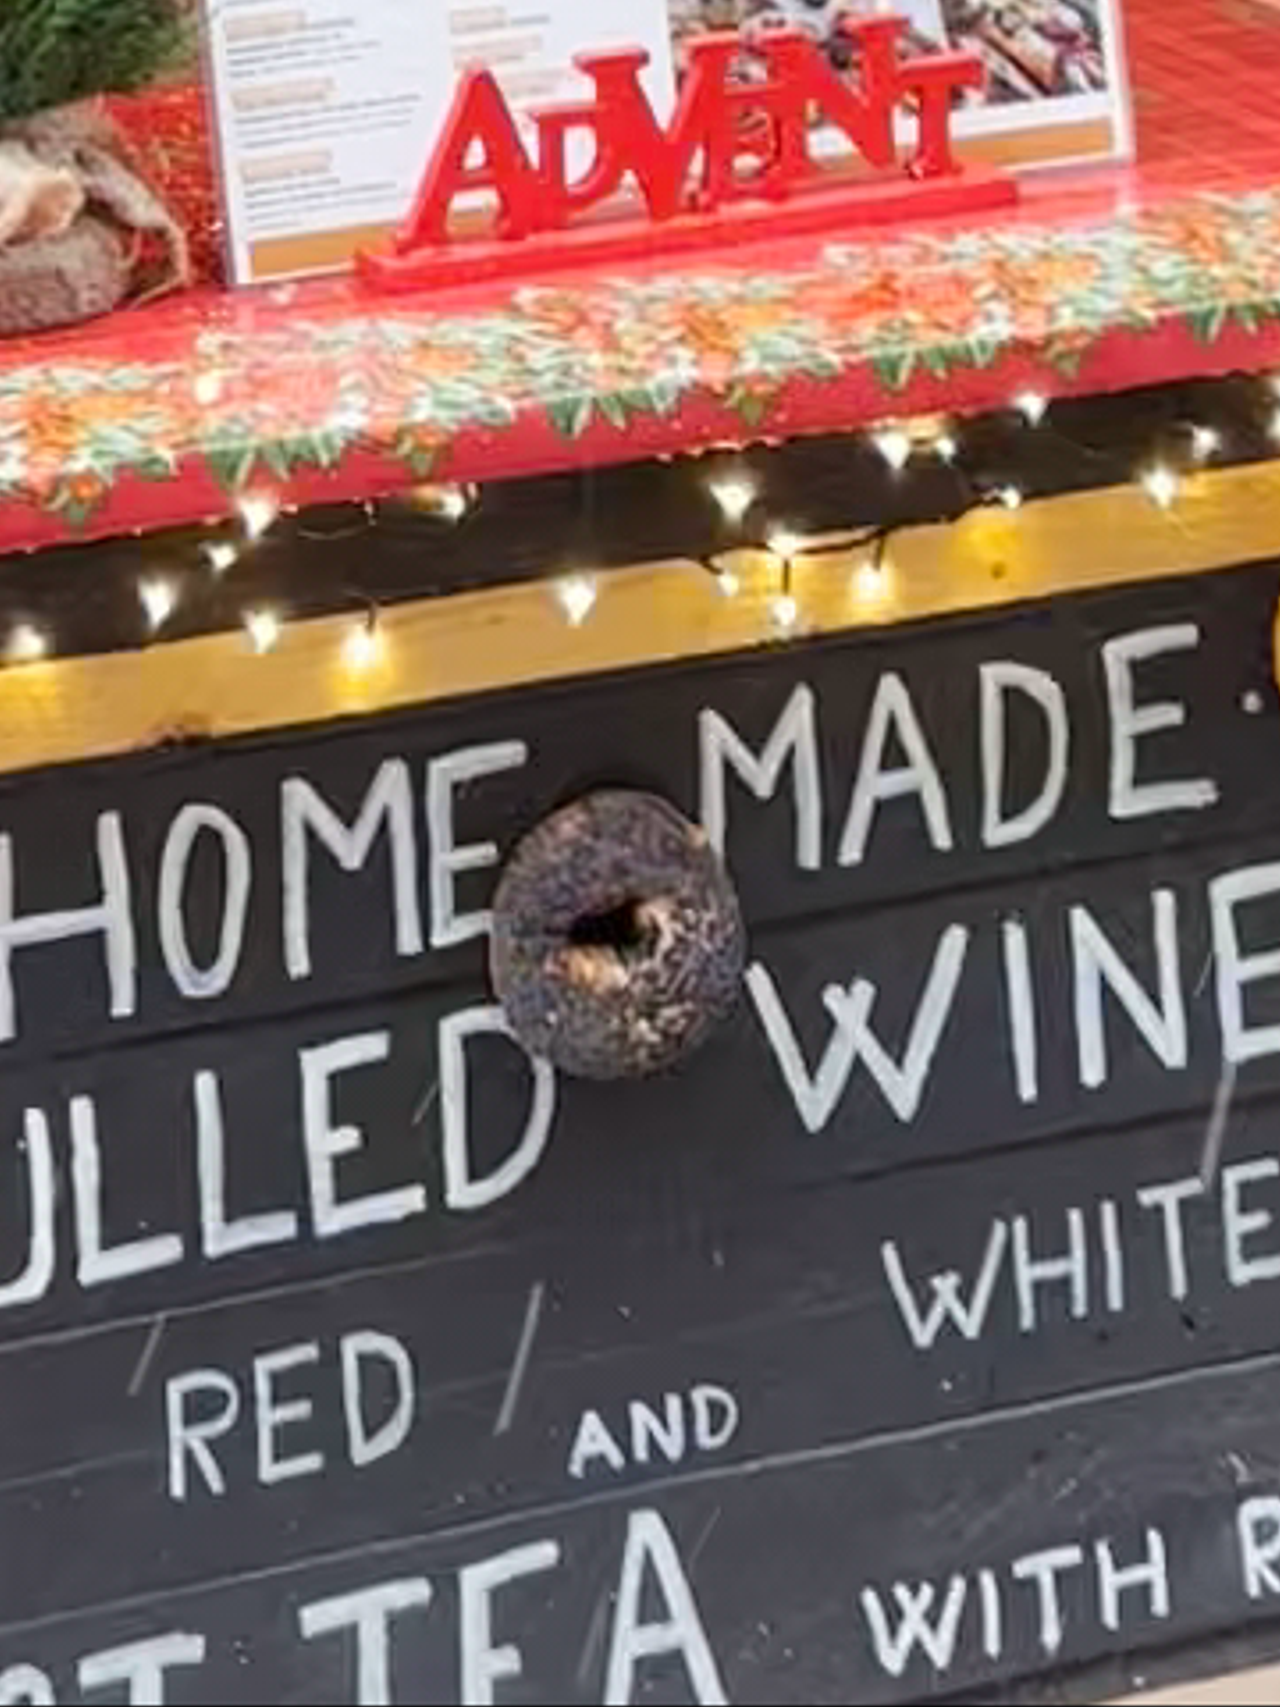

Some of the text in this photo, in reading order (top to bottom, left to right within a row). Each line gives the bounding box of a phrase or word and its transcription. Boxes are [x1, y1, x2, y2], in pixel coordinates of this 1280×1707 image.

[697, 623, 1220, 871] MADE
[166, 1330, 418, 1501] RED
[565, 1383, 741, 1478] AND
[860, 1526, 1172, 1678] WITH
